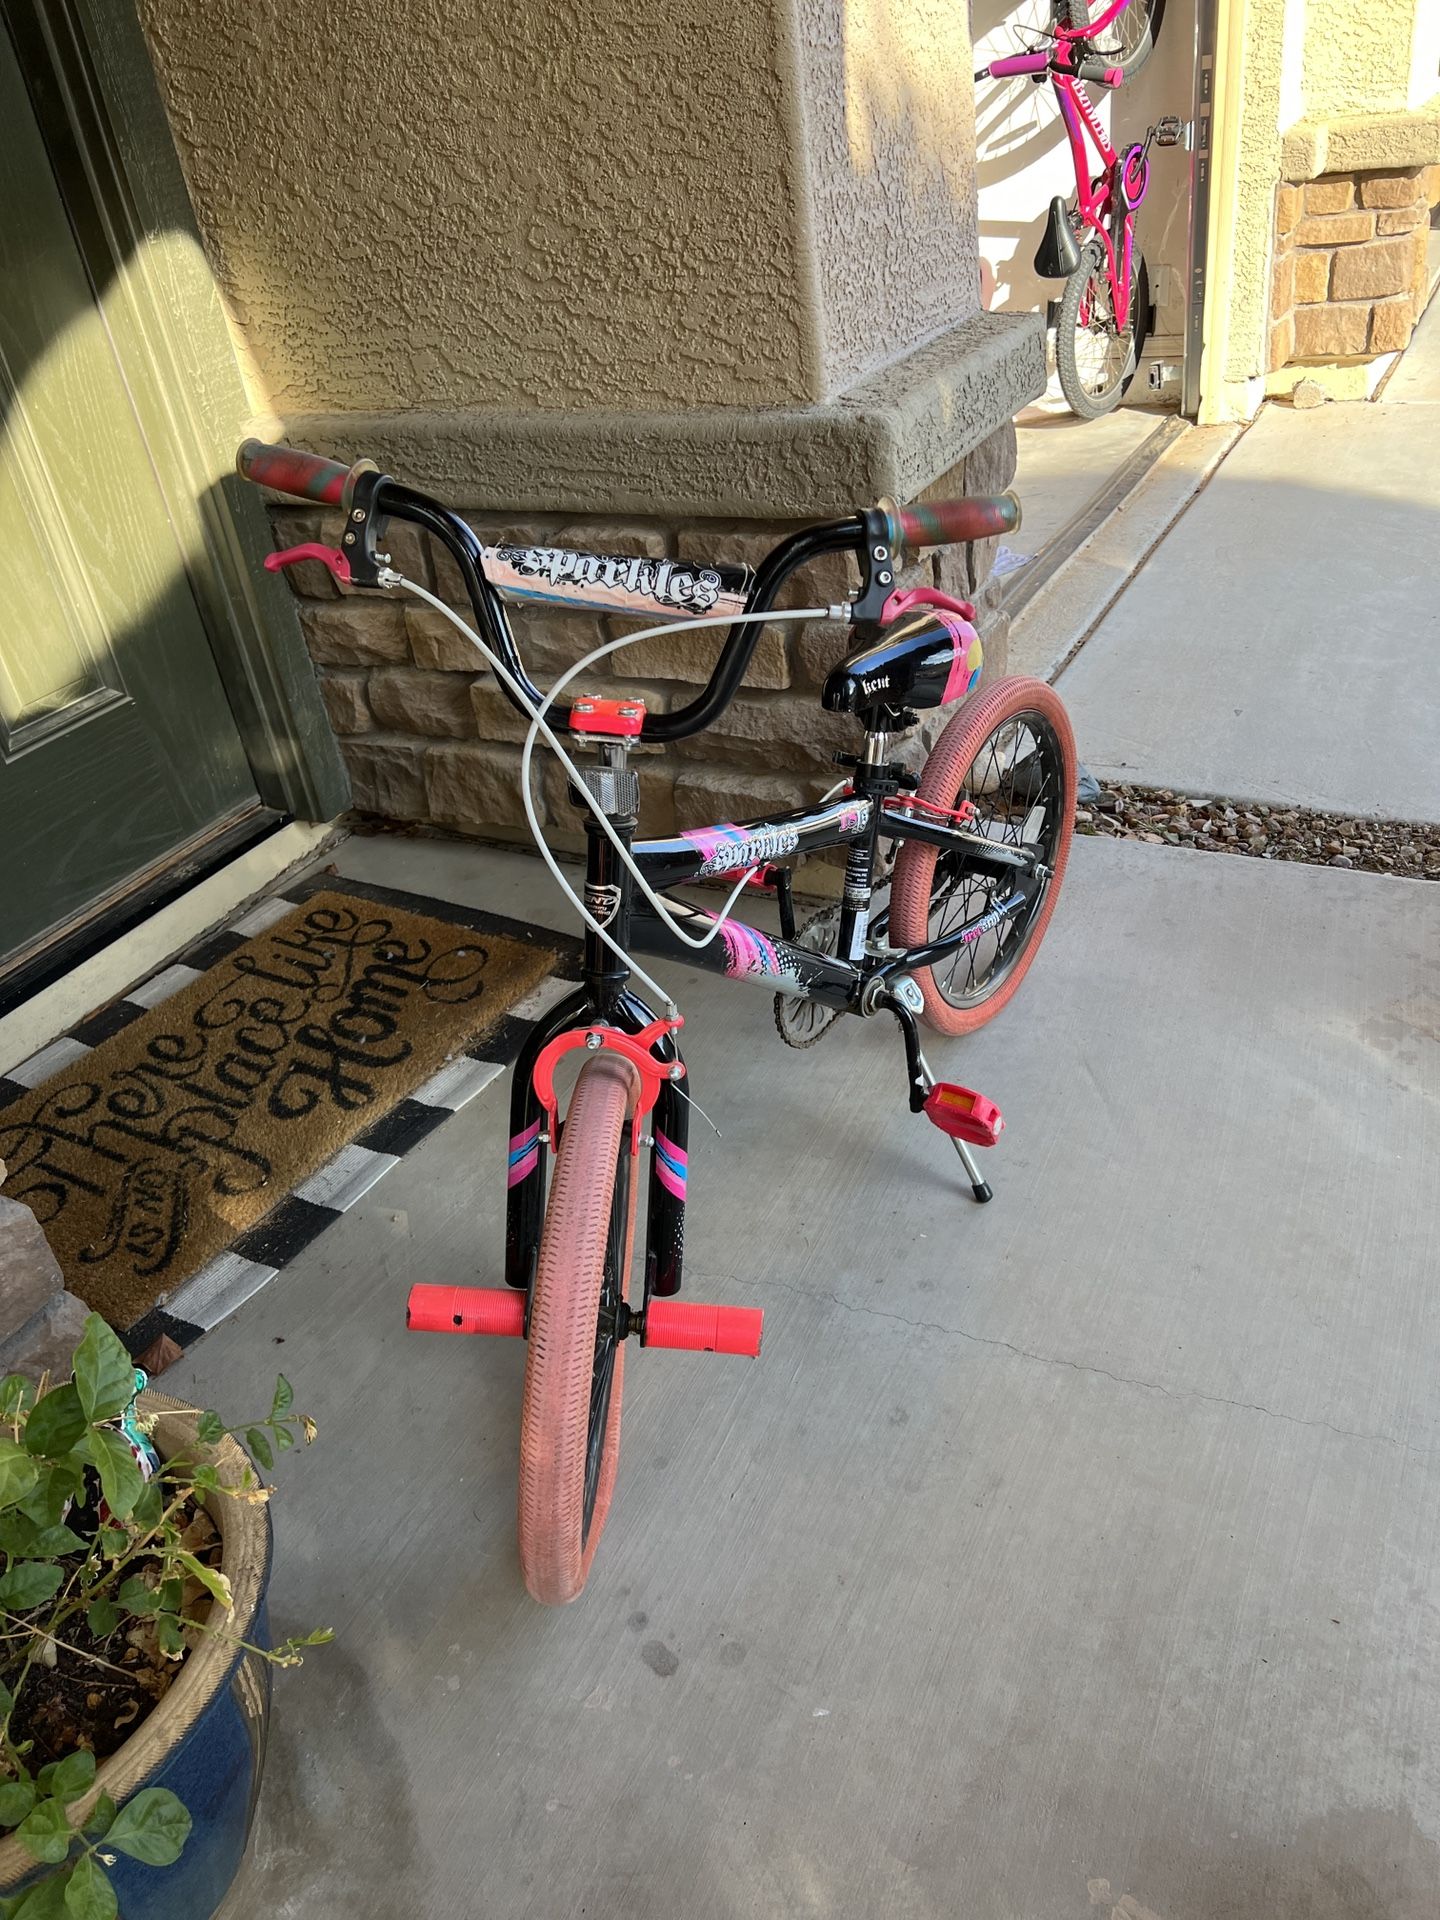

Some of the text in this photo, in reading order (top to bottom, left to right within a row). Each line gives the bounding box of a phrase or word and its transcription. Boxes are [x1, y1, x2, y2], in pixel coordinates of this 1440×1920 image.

[861, 674, 890, 695] kent
[161, 998, 312, 1196] place
[267, 937, 489, 1120] Home
[0, 1033, 208, 1224] There
